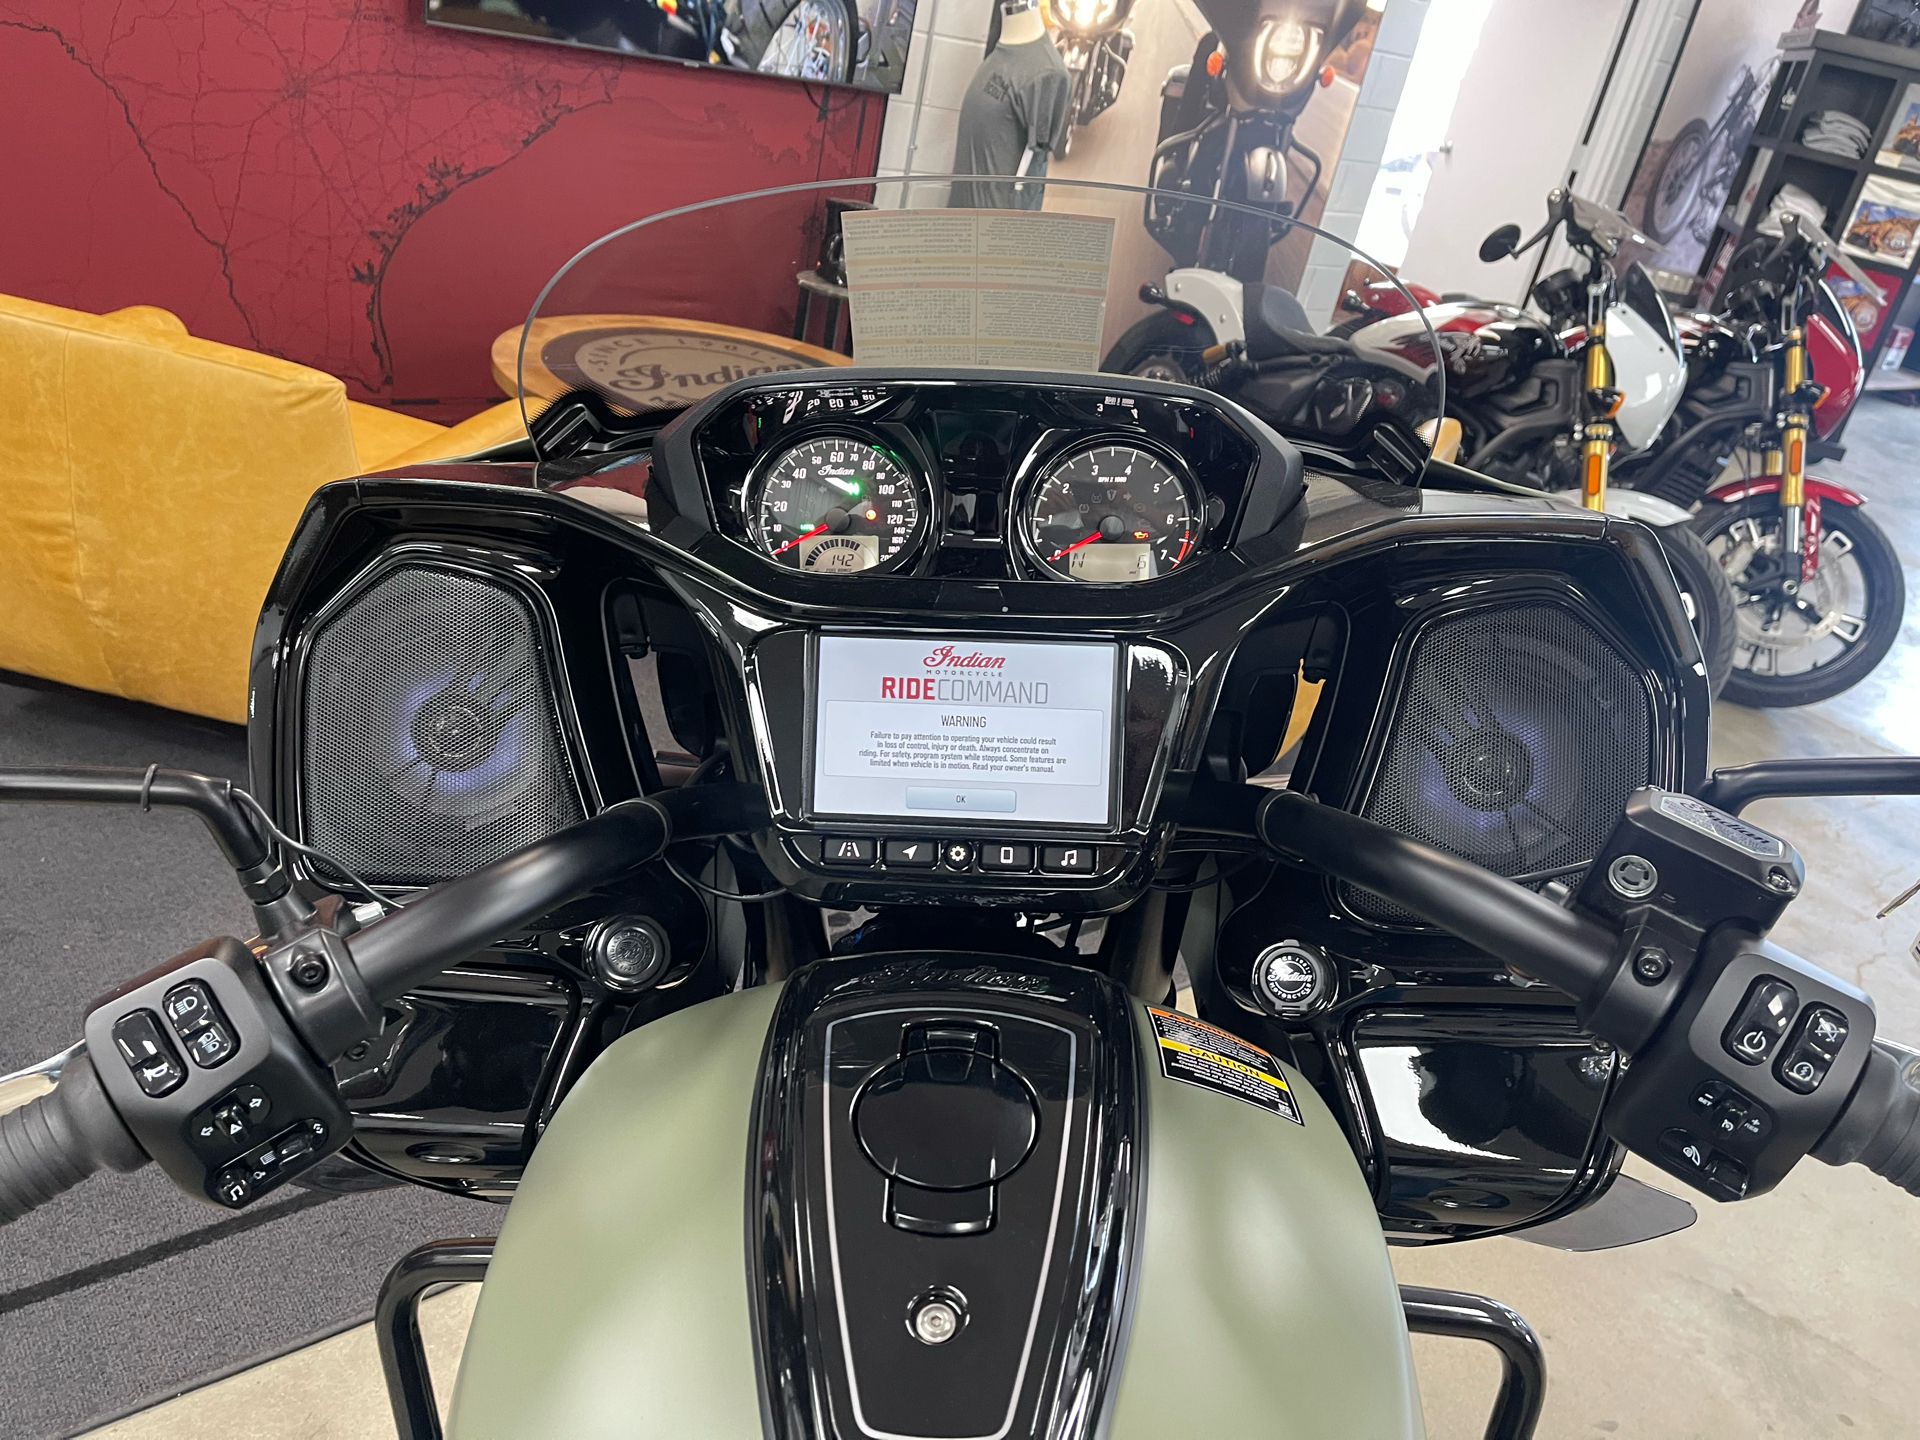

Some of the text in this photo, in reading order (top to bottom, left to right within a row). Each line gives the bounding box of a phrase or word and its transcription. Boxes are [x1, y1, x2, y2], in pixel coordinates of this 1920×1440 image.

[588, 338, 652, 366] SINCE
[812, 456, 822, 464] 50
[830, 452, 844, 462] 60
[818, 465, 855, 475] Indian
[862, 460, 875, 470] 80
[1091, 465, 1098, 475] 3
[1125, 465, 1132, 475] 4
[792, 468, 806, 479] 40
[878, 485, 895, 495] 100
[1062, 484, 1069, 494] 2
[1154, 484, 1160, 493] 5
[774, 501, 788, 512] 20
[887, 515, 903, 524] 120
[1048, 515, 1052, 524] 1
[1166, 514, 1174, 524] 6
[773, 524, 782, 532] 10
[832, 554, 854, 566] 142
[1072, 552, 1085, 568] N
[1160, 550, 1167, 560] 7
[922, 645, 1006, 669] Indian
[941, 715, 986, 728] WARNING
[870, 731, 891, 739] Failure
[951, 735, 980, 744] operating
[932, 743, 948, 751] injury
[979, 745, 1000, 753] Always
[892, 751, 912, 759] safety,
[956, 795, 966, 804] OK
[1680, 802, 1770, 844] Indian
[1267, 970, 1312, 982] Indian
[1269, 982, 1312, 999] MOTORCYCLE
[1189, 1047, 1260, 1078] CAUTION
